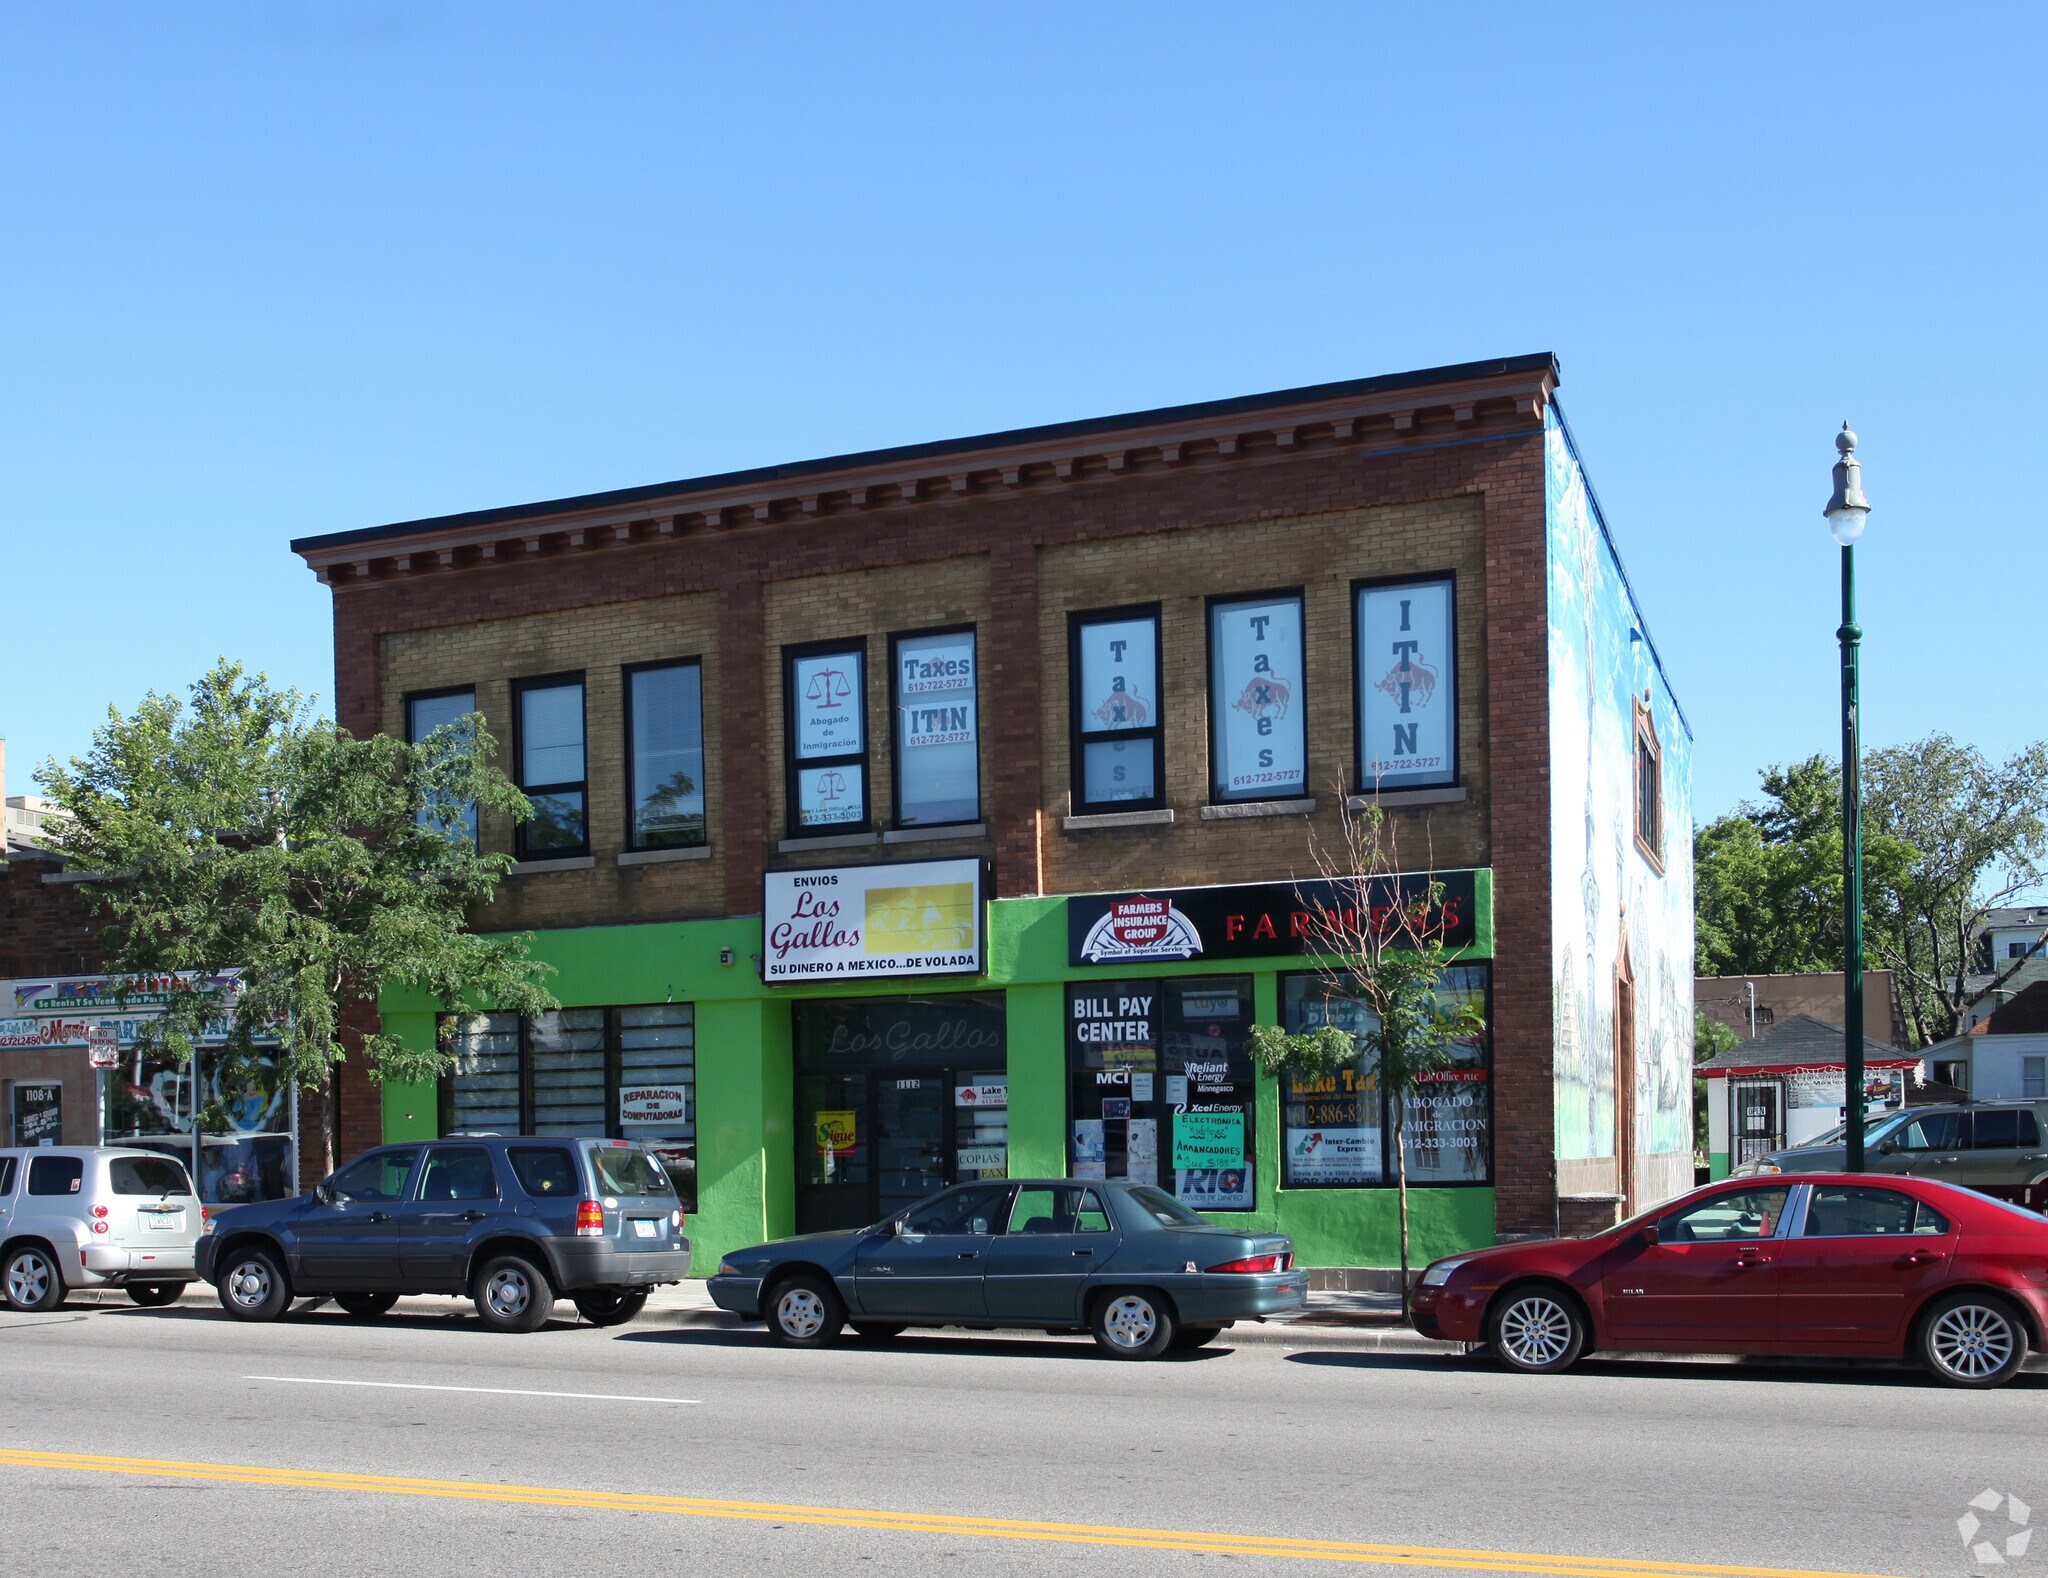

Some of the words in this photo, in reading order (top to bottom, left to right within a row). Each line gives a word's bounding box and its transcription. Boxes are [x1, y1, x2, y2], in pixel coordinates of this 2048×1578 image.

[904, 658, 970, 680] Taxes
[1392, 599, 1419, 756] ITIN
[908, 677, 968, 692] 612-722-5727
[1249, 615, 1274, 768] Taxes
[809, 715, 850, 726] Abogado
[911, 706, 968, 734] ITIN
[822, 729, 834, 737] de
[910, 731, 970, 745] 612-722-5727
[803, 738, 857, 751] Inmigración
[1371, 757, 1441, 771] 612-722-5727
[1233, 769, 1301, 786] 612-722-5727
[802, 810, 862, 823] 612-333-3003
[793, 875, 839, 887] ENVIOS
[790, 891, 840, 920] Los
[1118, 902, 1163, 915] FARMERS
[1113, 914, 1168, 928] INSURANCE
[1226, 901, 1461, 942] FARMERS
[770, 920, 860, 960] Gallos
[1123, 927, 1157, 940] GROUP
[1100, 948, 1124, 956] Symbol
[1133, 946, 1159, 955] Superior
[770, 965, 786, 974] SU
[789, 962, 834, 974] DINERO
[837, 961, 845, 971] A
[925, 955, 975, 967] VOLADA
[38, 999, 49, 1008] Se
[50, 998, 75, 1007] Renta
[76, 998, 82, 1006] Y
[83, 998, 93, 1006] Se
[1074, 998, 1113, 1018] BILL
[1119, 996, 1152, 1017] PAY
[97, 1030, 108, 1038] NO
[1077, 1020, 1150, 1043] CENTER
[91, 1038, 117, 1046] PARKING
[827, 1024, 882, 1054] Los
[886, 1020, 1000, 1061] Gallos
[1188, 1062, 1229, 1073] Reliant
[1096, 1072, 1129, 1085] MCI
[1197, 1073, 1225, 1084] Energy
[1435, 1070, 1460, 1082] Office
[1463, 1072, 1480, 1081] PLLC
[897, 1079, 920, 1089] 1112
[981, 1086, 1002, 1095] Lake
[1197, 1084, 1234, 1094] Minnegasco
[26, 1089, 54, 1102] 1108-A
[623, 1089, 682, 1104] REPARACION
[646, 1102, 660, 1110] DE
[1403, 1096, 1474, 1109] ABOGADO
[622, 1108, 683, 1121] COMPUTADORAS
[1748, 1107, 1765, 1115] OPEN
[817, 1122, 855, 1145] Sigue
[1325, 1137, 1375, 1146] Inter-Cambio
[1402, 1136, 1478, 1149] 612-333-3003
[1337, 1146, 1366, 1154] Express
[959, 1153, 1000, 1165] COPIAS
[981, 1168, 1001, 1179] FAX
[1217, 1193, 1243, 1201] DINERO
